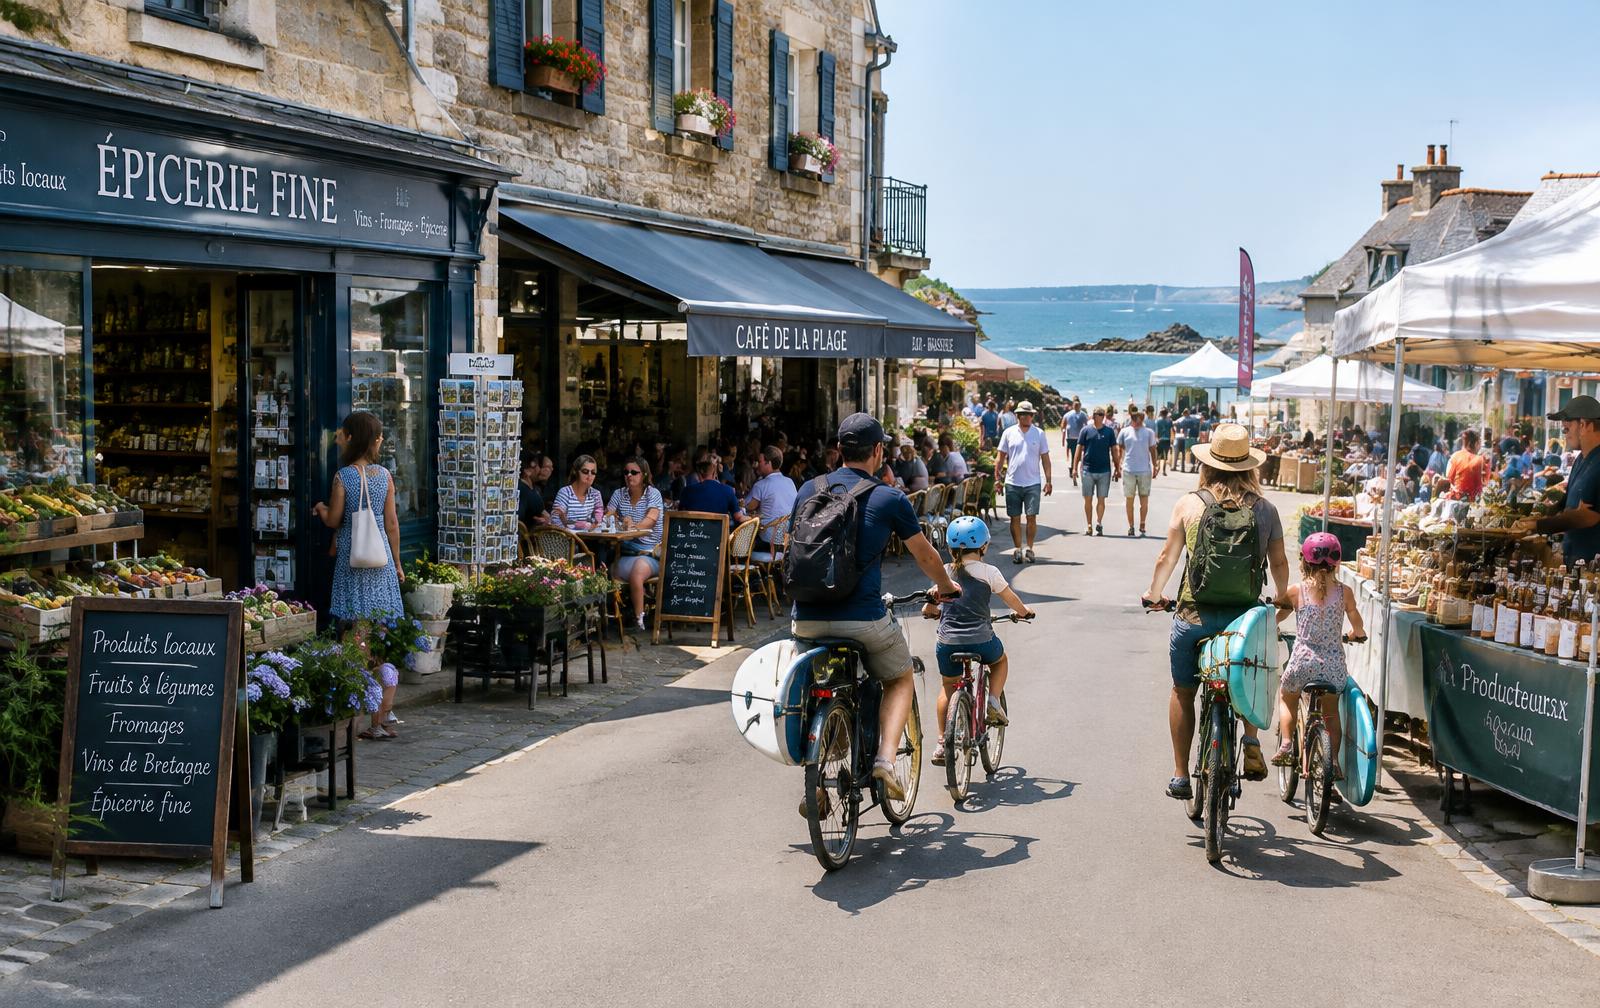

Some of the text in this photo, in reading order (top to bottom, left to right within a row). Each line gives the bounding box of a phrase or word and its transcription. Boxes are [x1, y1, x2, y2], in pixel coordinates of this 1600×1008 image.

[20, 162, 67, 191] locaux
[96, 131, 338, 225] ÉPICERIE FINE
[736, 322, 848, 352] CAFÉ DE LA PLAGE
[92, 629, 217, 656] Produits locaux
[88, 669, 215, 705] Fruits & légumes
[107, 711, 185, 744] Fromages
[82, 748, 114, 773] Vins
[119, 752, 138, 773] de
[91, 786, 192, 822] Épicerie fine
